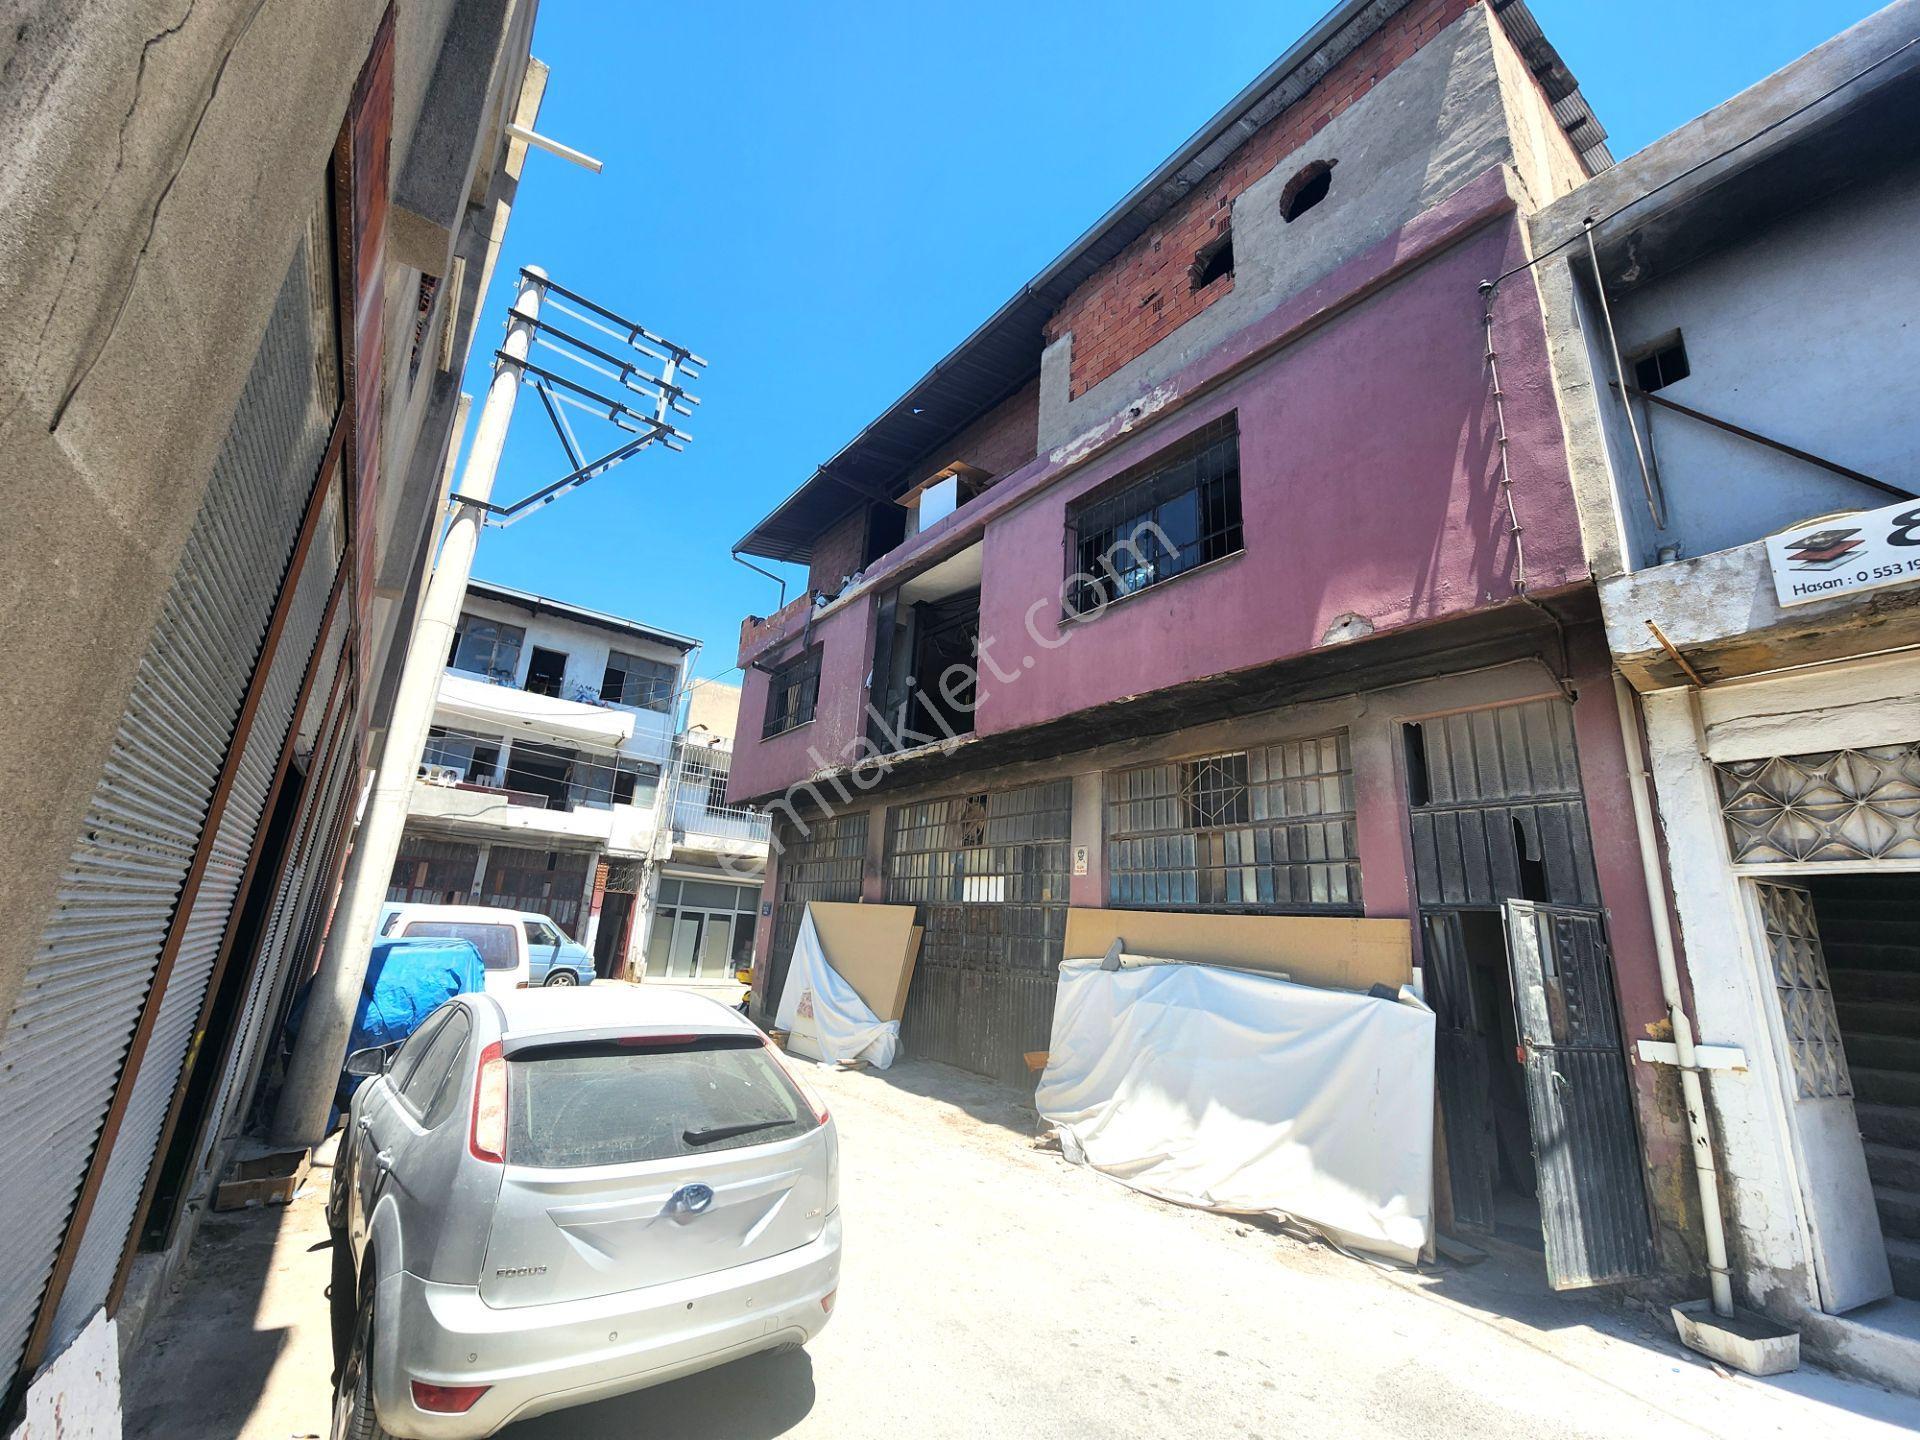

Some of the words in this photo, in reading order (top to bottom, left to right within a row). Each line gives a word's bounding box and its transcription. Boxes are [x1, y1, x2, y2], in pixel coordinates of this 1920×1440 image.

[1793, 578, 1843, 596] Hasan
[1874, 564, 1902, 578] 553
[496, 1265, 547, 1278] FOCUS
